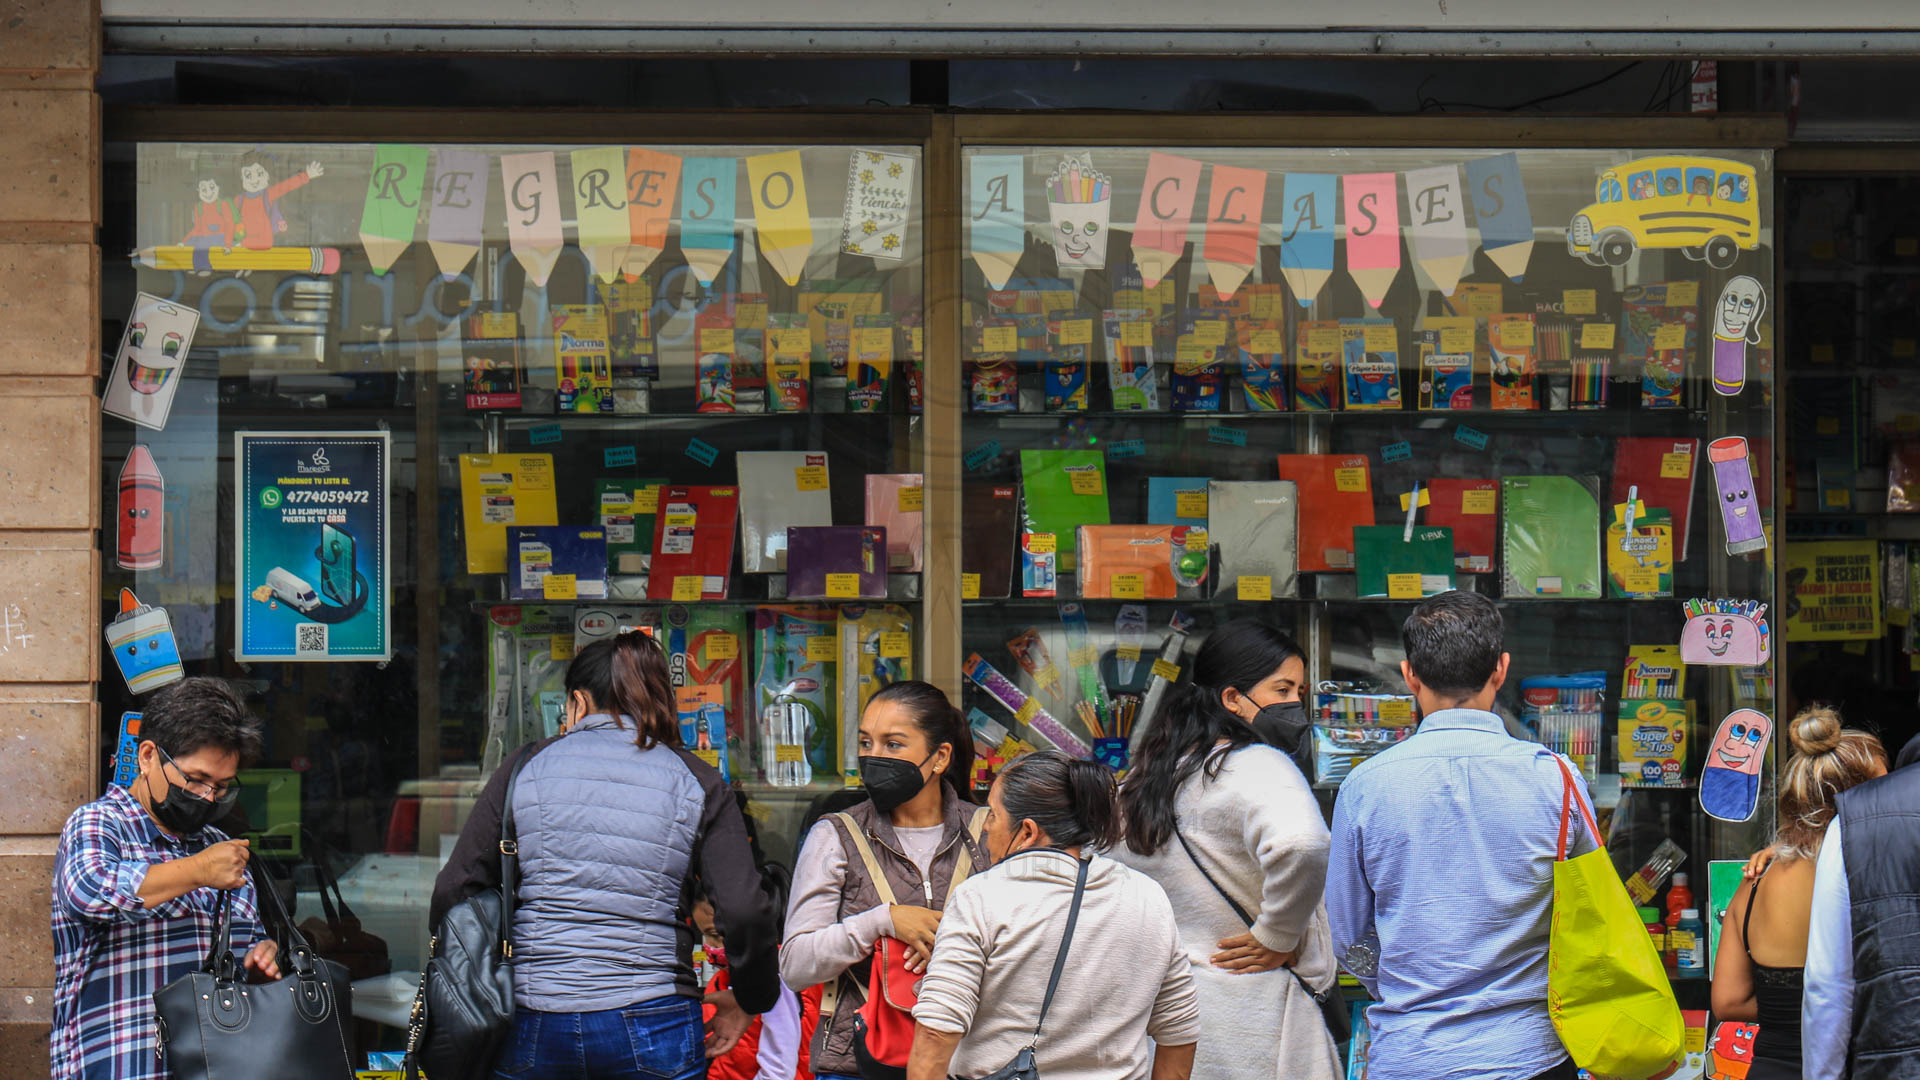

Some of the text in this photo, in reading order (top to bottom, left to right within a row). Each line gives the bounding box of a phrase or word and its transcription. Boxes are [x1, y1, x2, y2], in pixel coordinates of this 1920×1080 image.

[560, 332, 605, 352] Norma
[476, 396, 488, 405] 12
[287, 490, 369, 503] 4774059472
[326, 515, 346, 523] CASA
[1827, 567, 1871, 581] NECESITA
[1636, 662, 1671, 677] Norma
[1632, 730, 1669, 741] Super
[1650, 742, 1674, 753] Tips
